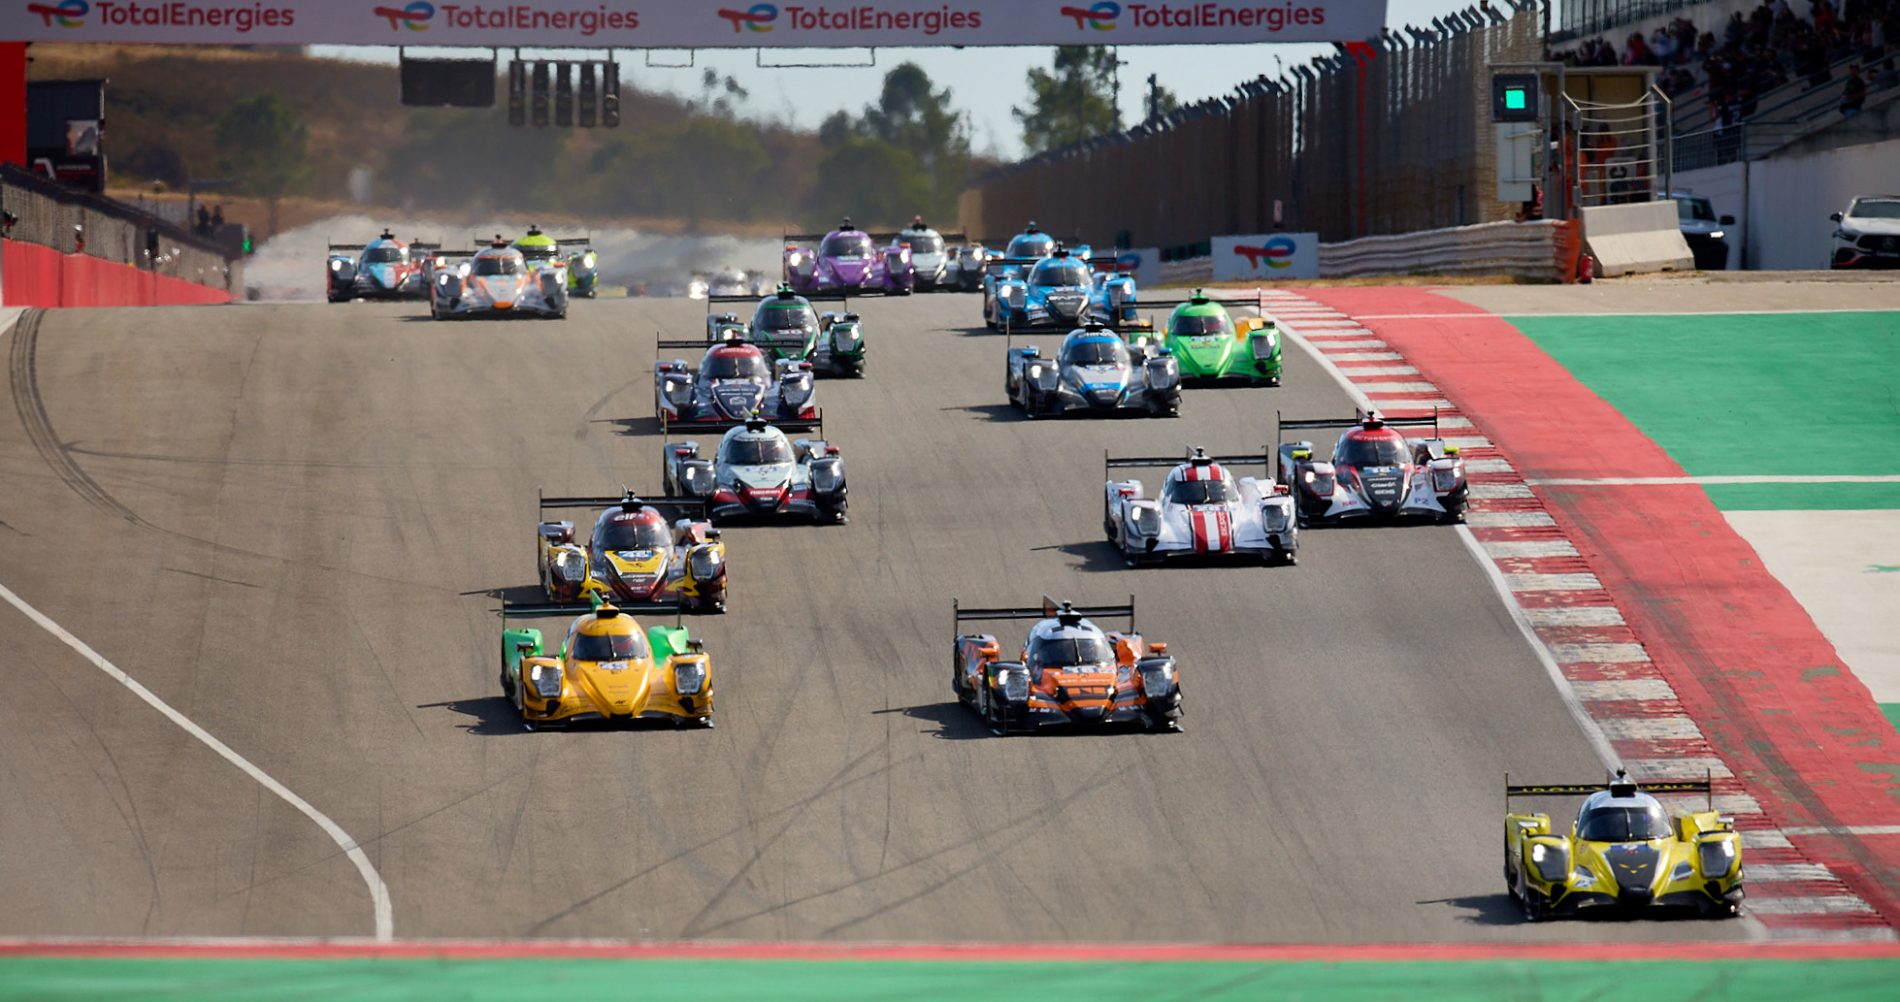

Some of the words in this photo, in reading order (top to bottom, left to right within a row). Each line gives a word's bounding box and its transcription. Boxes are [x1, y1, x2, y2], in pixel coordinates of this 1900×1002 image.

[96, 1, 295, 33] TotalEnergies
[440, 5, 640, 37] TotalEnergies
[785, 5, 982, 36] TotalEnergies
[1128, 1, 1325, 32] TotalEnergies
